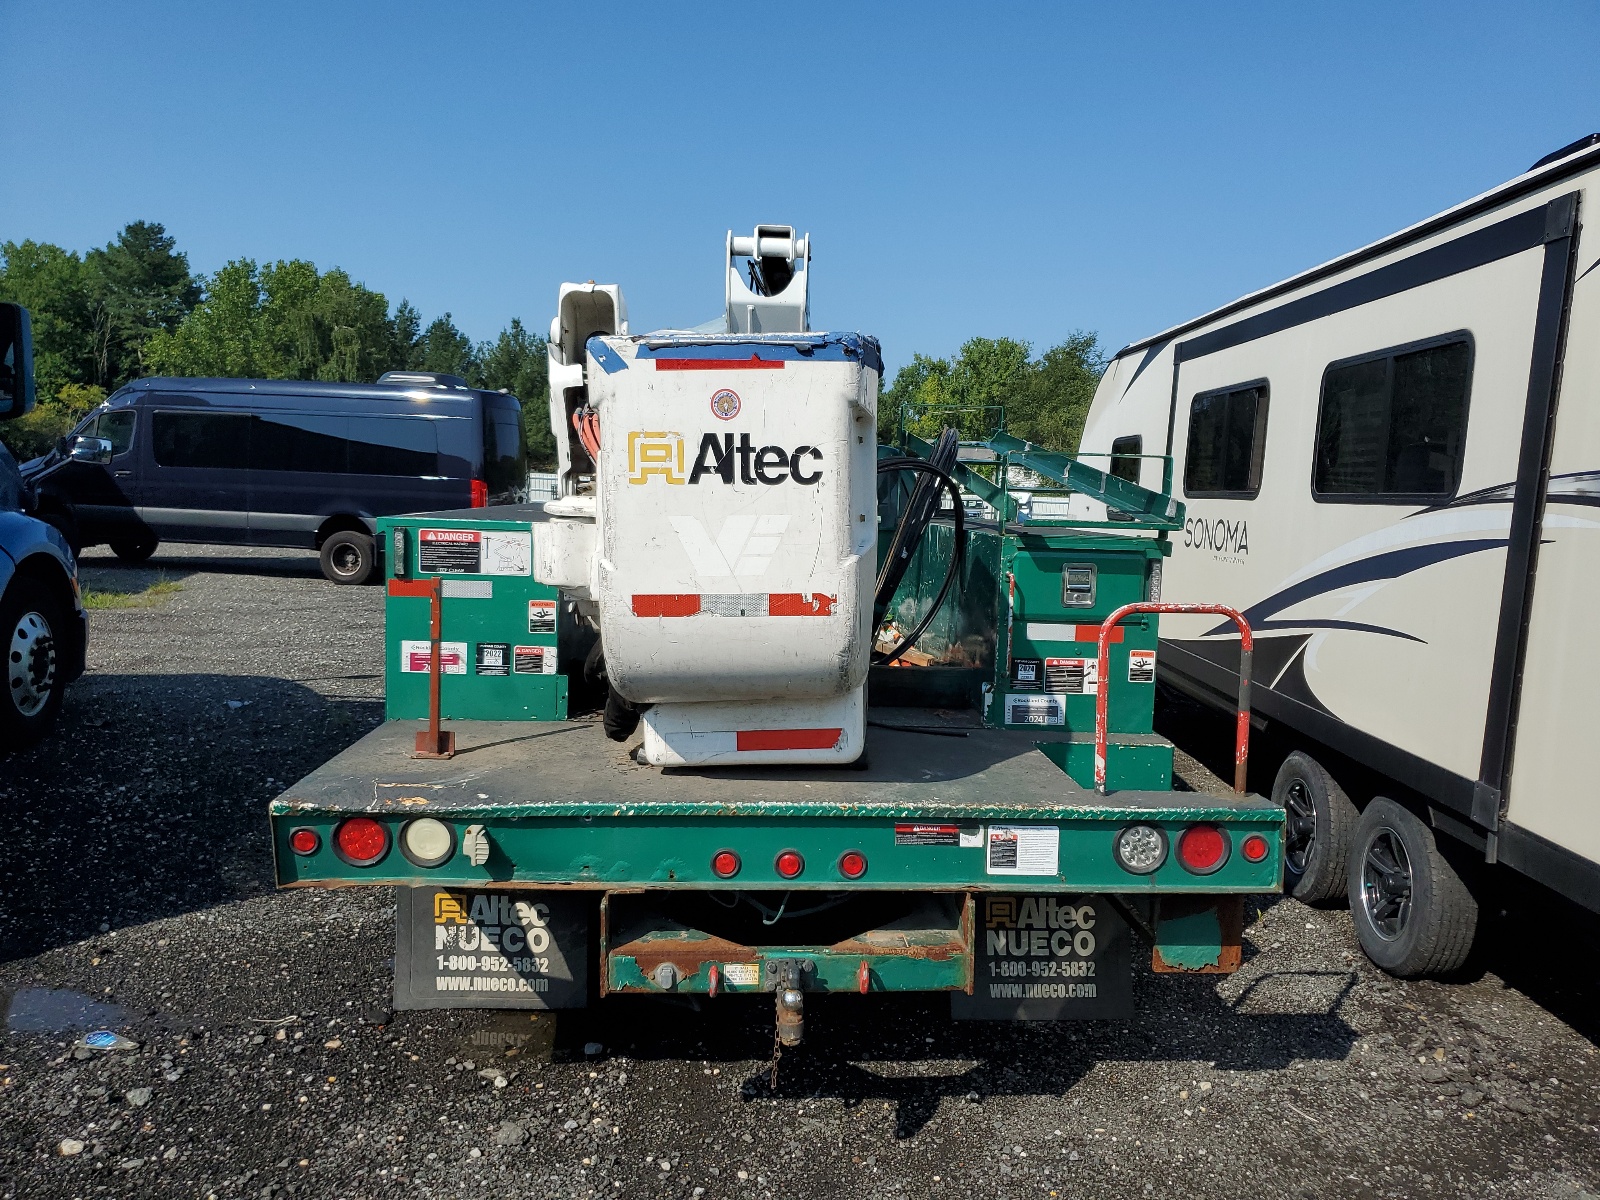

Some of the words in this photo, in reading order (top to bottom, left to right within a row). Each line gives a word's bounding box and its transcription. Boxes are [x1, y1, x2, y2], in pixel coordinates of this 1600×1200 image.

[688, 432, 823, 485] Altec
[437, 532, 475, 541] DANGER
[1184, 517, 1249, 555] SONOMA
[485, 649, 502, 658] 2022
[1024, 715, 1043, 723] 2024
[467, 895, 550, 927] Altec
[1017, 897, 1096, 930] Altec
[435, 925, 550, 953] NUECO
[986, 930, 1096, 957] NUECO
[436, 954, 549, 973] 1-800-952-5832
[989, 961, 1096, 977] 1-800-952-5832
[436, 976, 549, 992] www.nueco.com
[990, 983, 1097, 998] www.nueco.com
